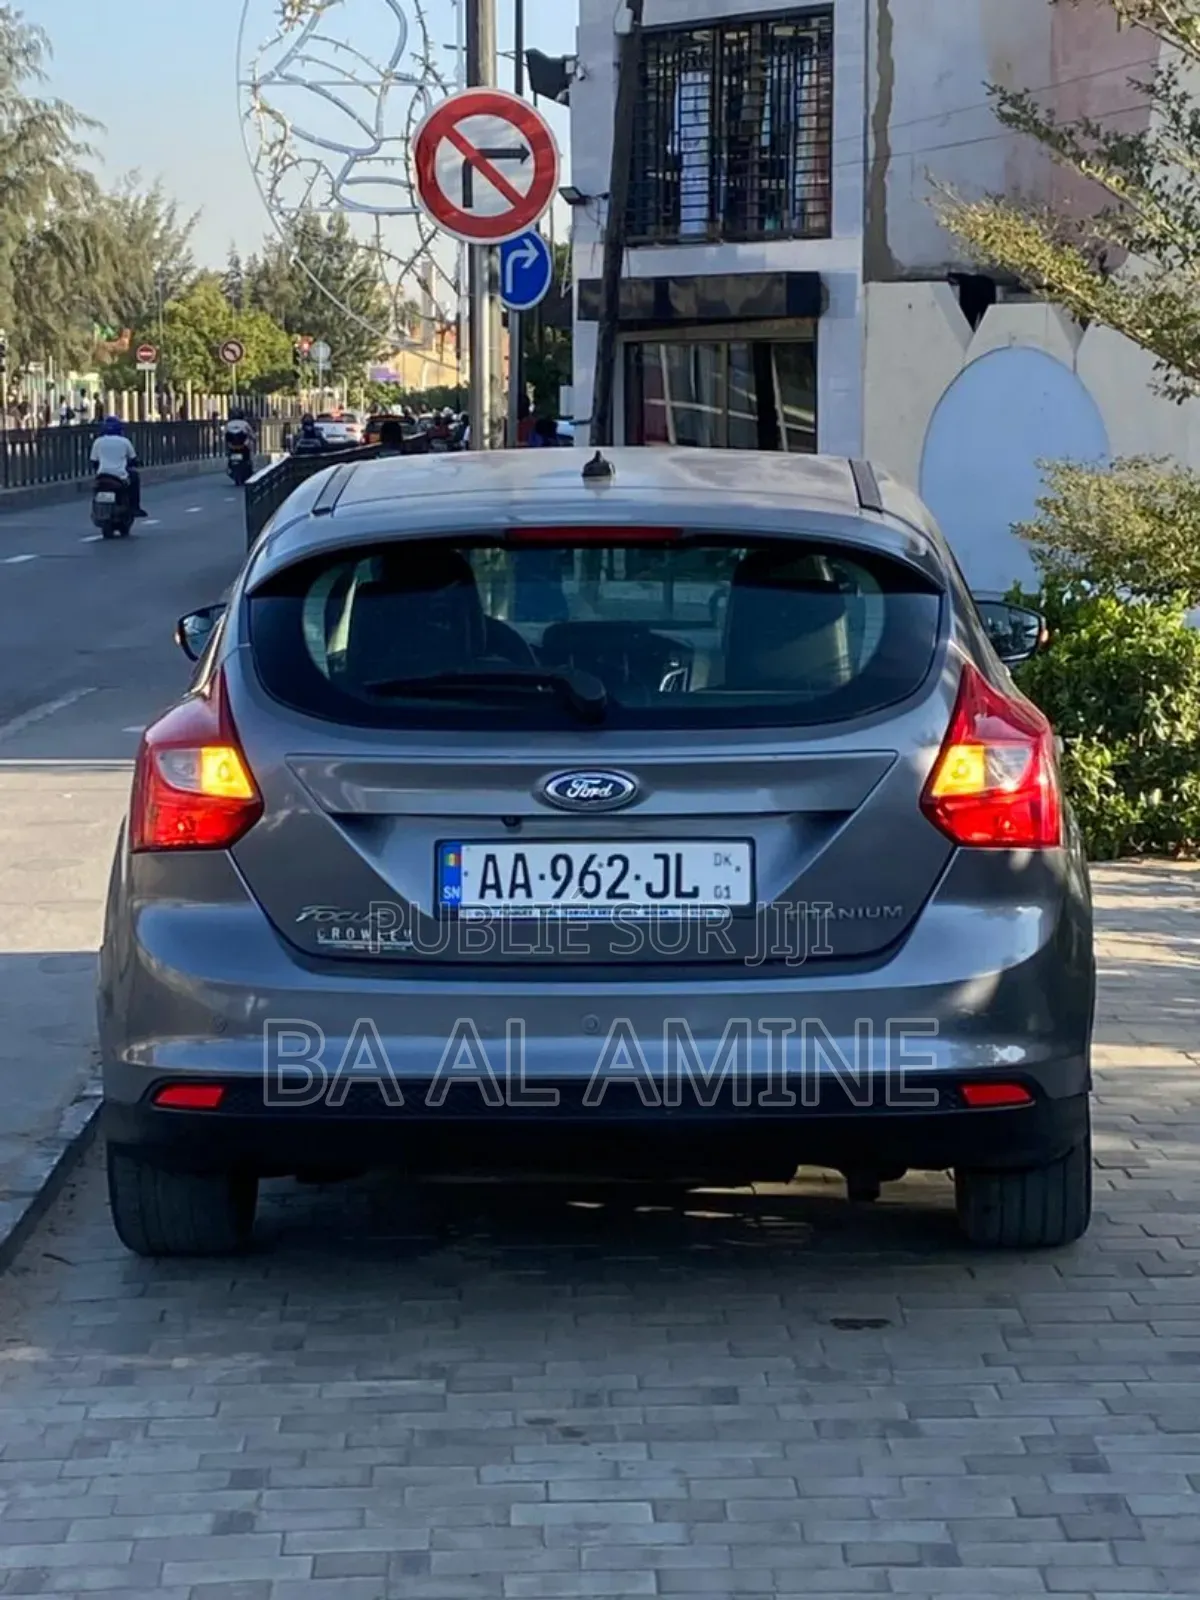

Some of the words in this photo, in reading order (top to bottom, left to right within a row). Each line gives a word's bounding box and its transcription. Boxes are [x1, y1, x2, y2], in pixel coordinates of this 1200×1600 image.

[566, 779, 614, 798] Ford
[713, 852, 732, 867] DK
[443, 885, 461, 900] SN
[713, 885, 732, 900] 01
[295, 904, 392, 922] Focus
[785, 905, 903, 921] TITANIUM
